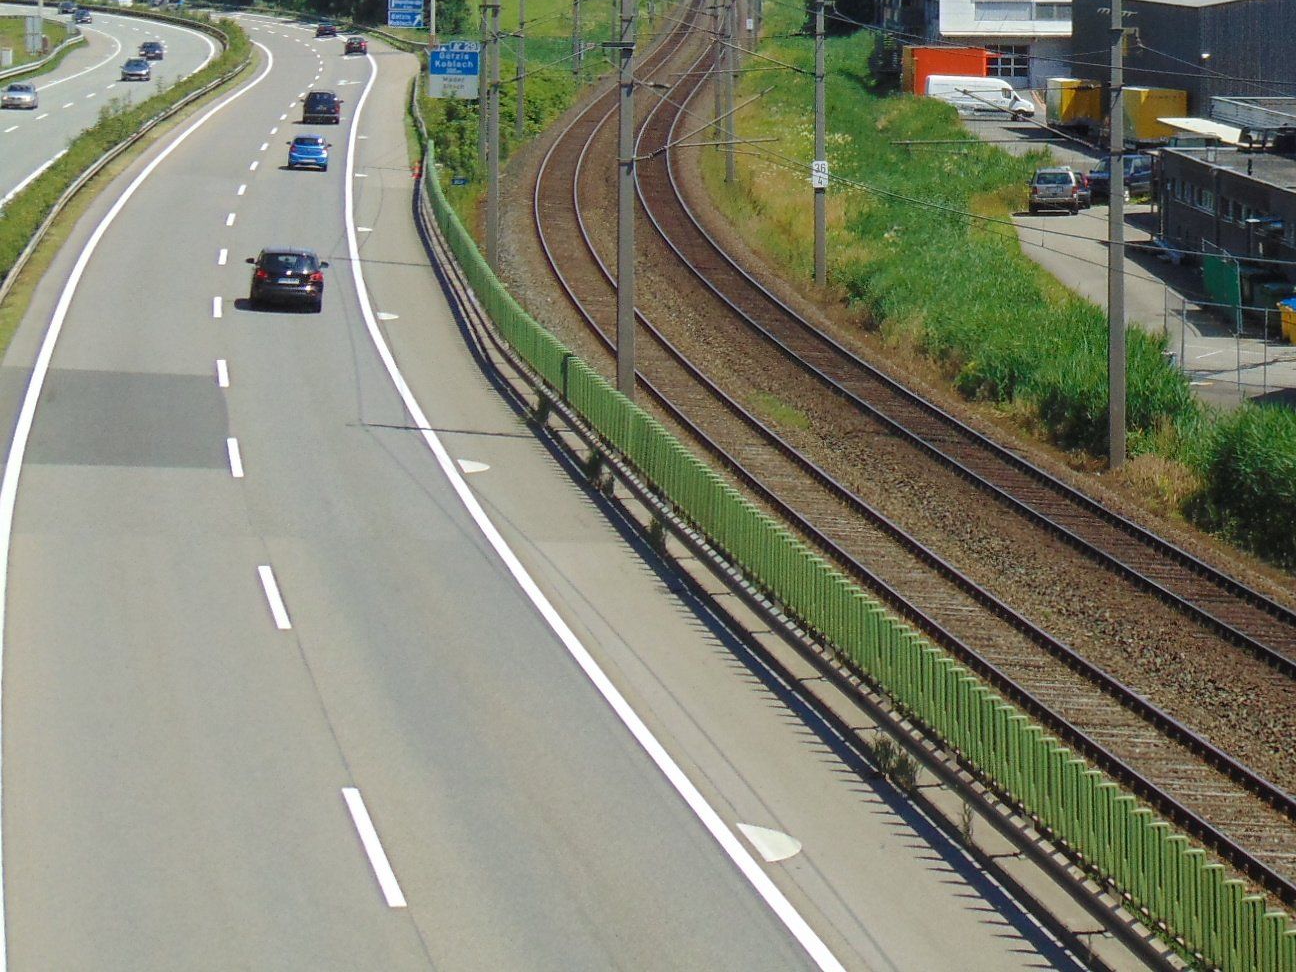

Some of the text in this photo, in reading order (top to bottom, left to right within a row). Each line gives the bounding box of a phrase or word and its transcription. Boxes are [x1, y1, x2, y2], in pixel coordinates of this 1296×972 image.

[464, 42, 477, 51] 29
[434, 60, 474, 68] Koblach
[815, 163, 826, 174] 36
[817, 176, 823, 185] 4
